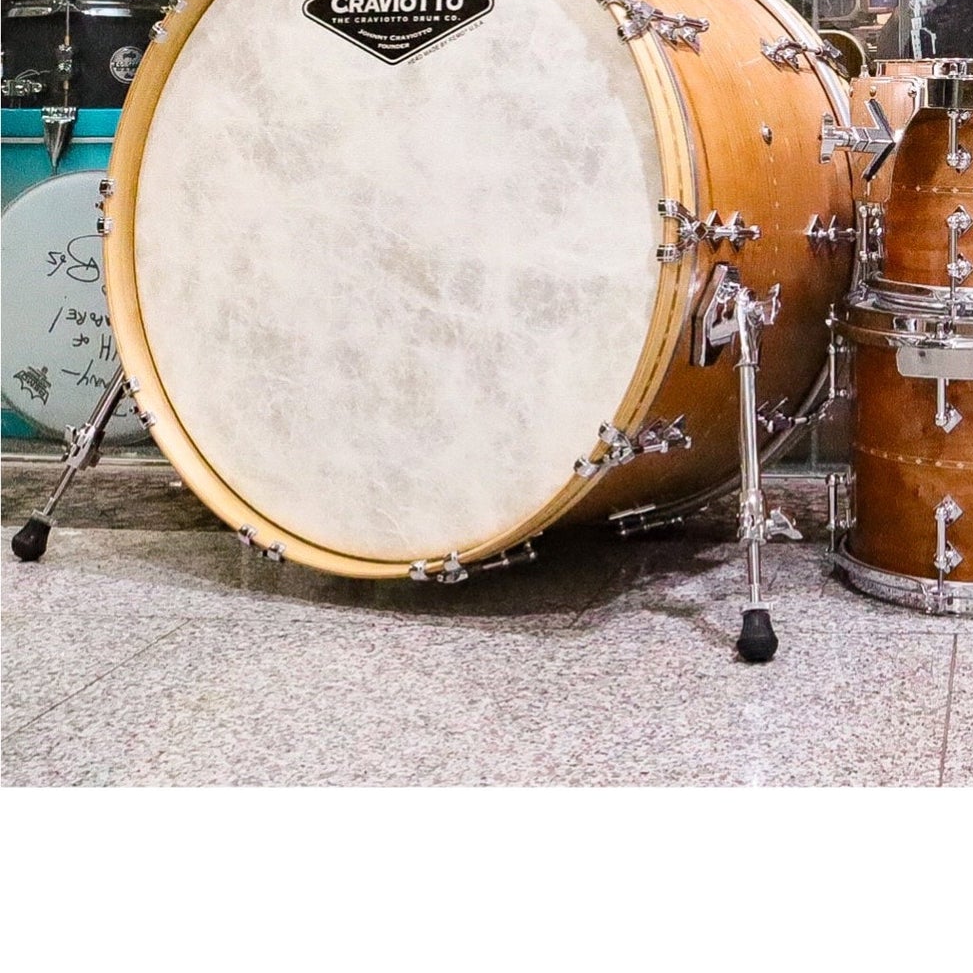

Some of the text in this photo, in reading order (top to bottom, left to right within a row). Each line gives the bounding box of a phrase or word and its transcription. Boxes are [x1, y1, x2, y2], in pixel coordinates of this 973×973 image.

[354, 16, 409, 24] CRAVIOTTO
[357, 27, 433, 42] JOHNNY CRAVIOTTO
